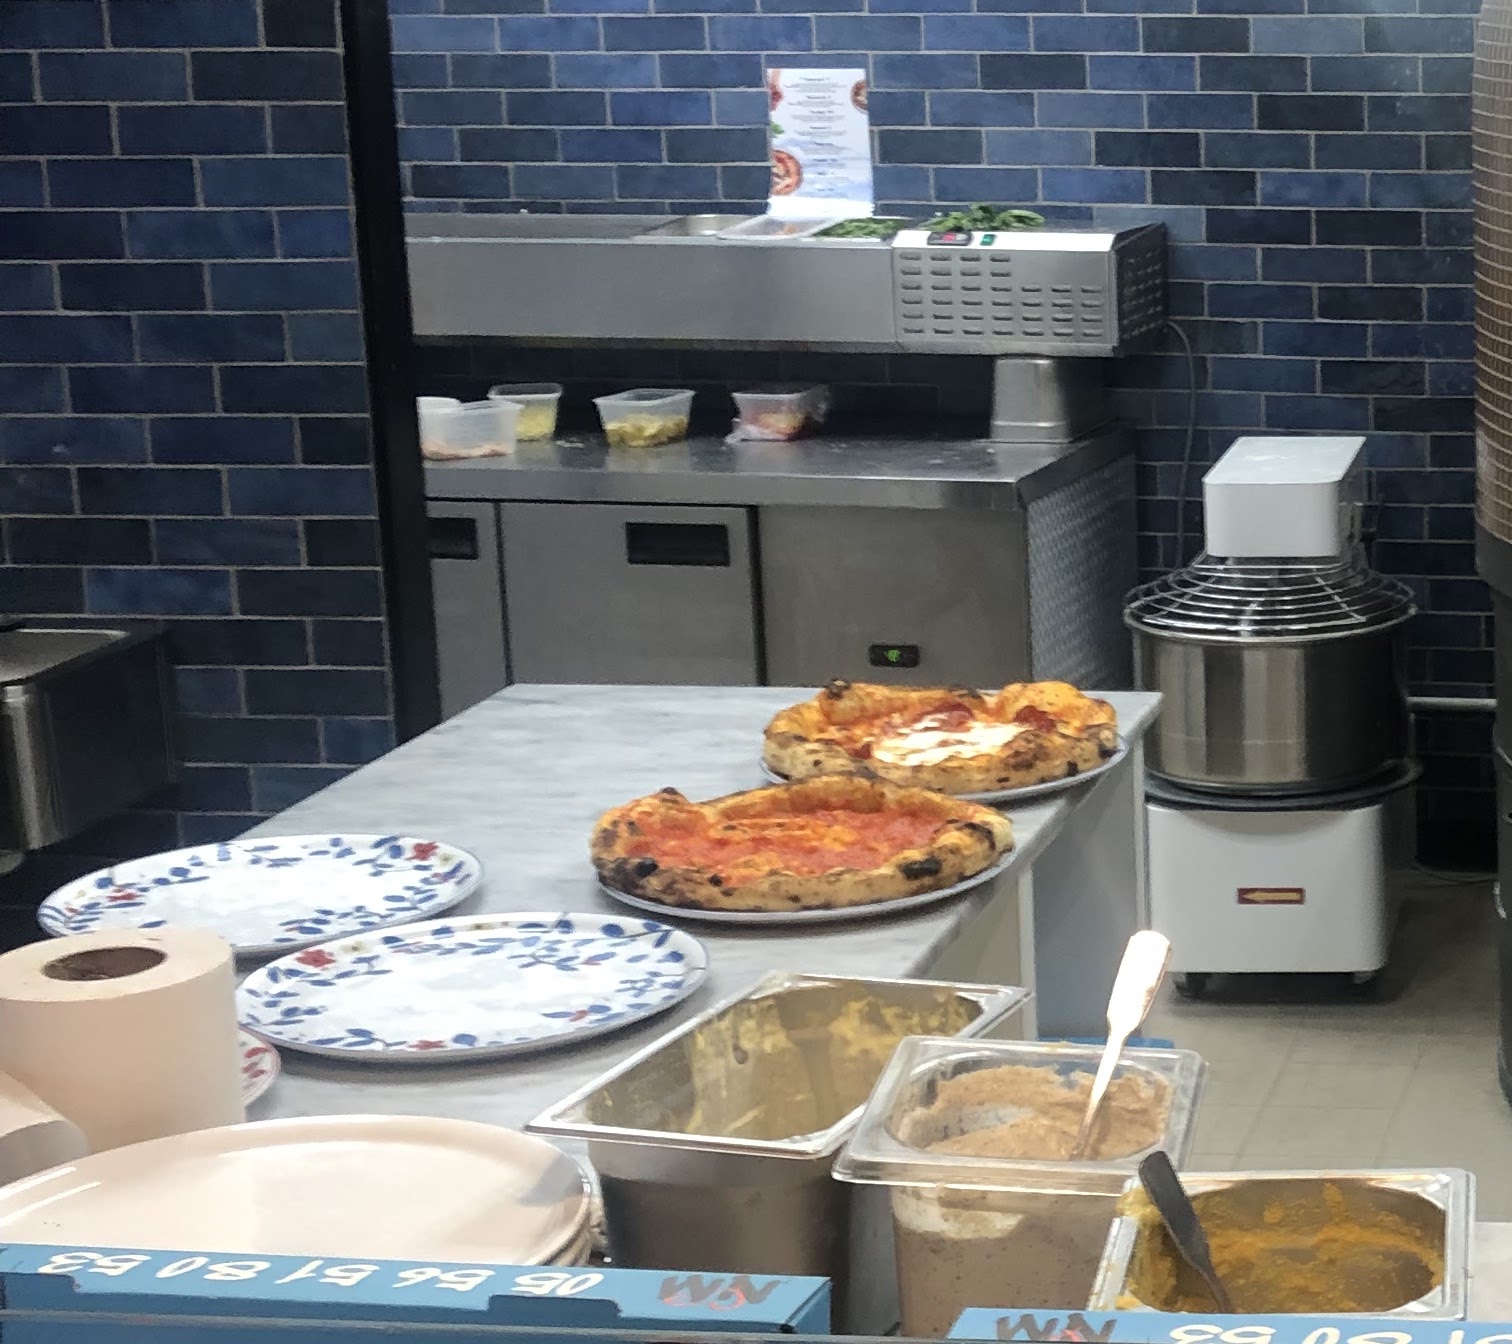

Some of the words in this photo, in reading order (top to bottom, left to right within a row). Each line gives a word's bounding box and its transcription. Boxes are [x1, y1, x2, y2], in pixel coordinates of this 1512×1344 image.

[37, 1251, 152, 1276] 53
[155, 1256, 271, 1281] 80
[274, 1259, 380, 1287] 51
[392, 1267, 495, 1292] 56
[511, 1272, 604, 1296] 05
